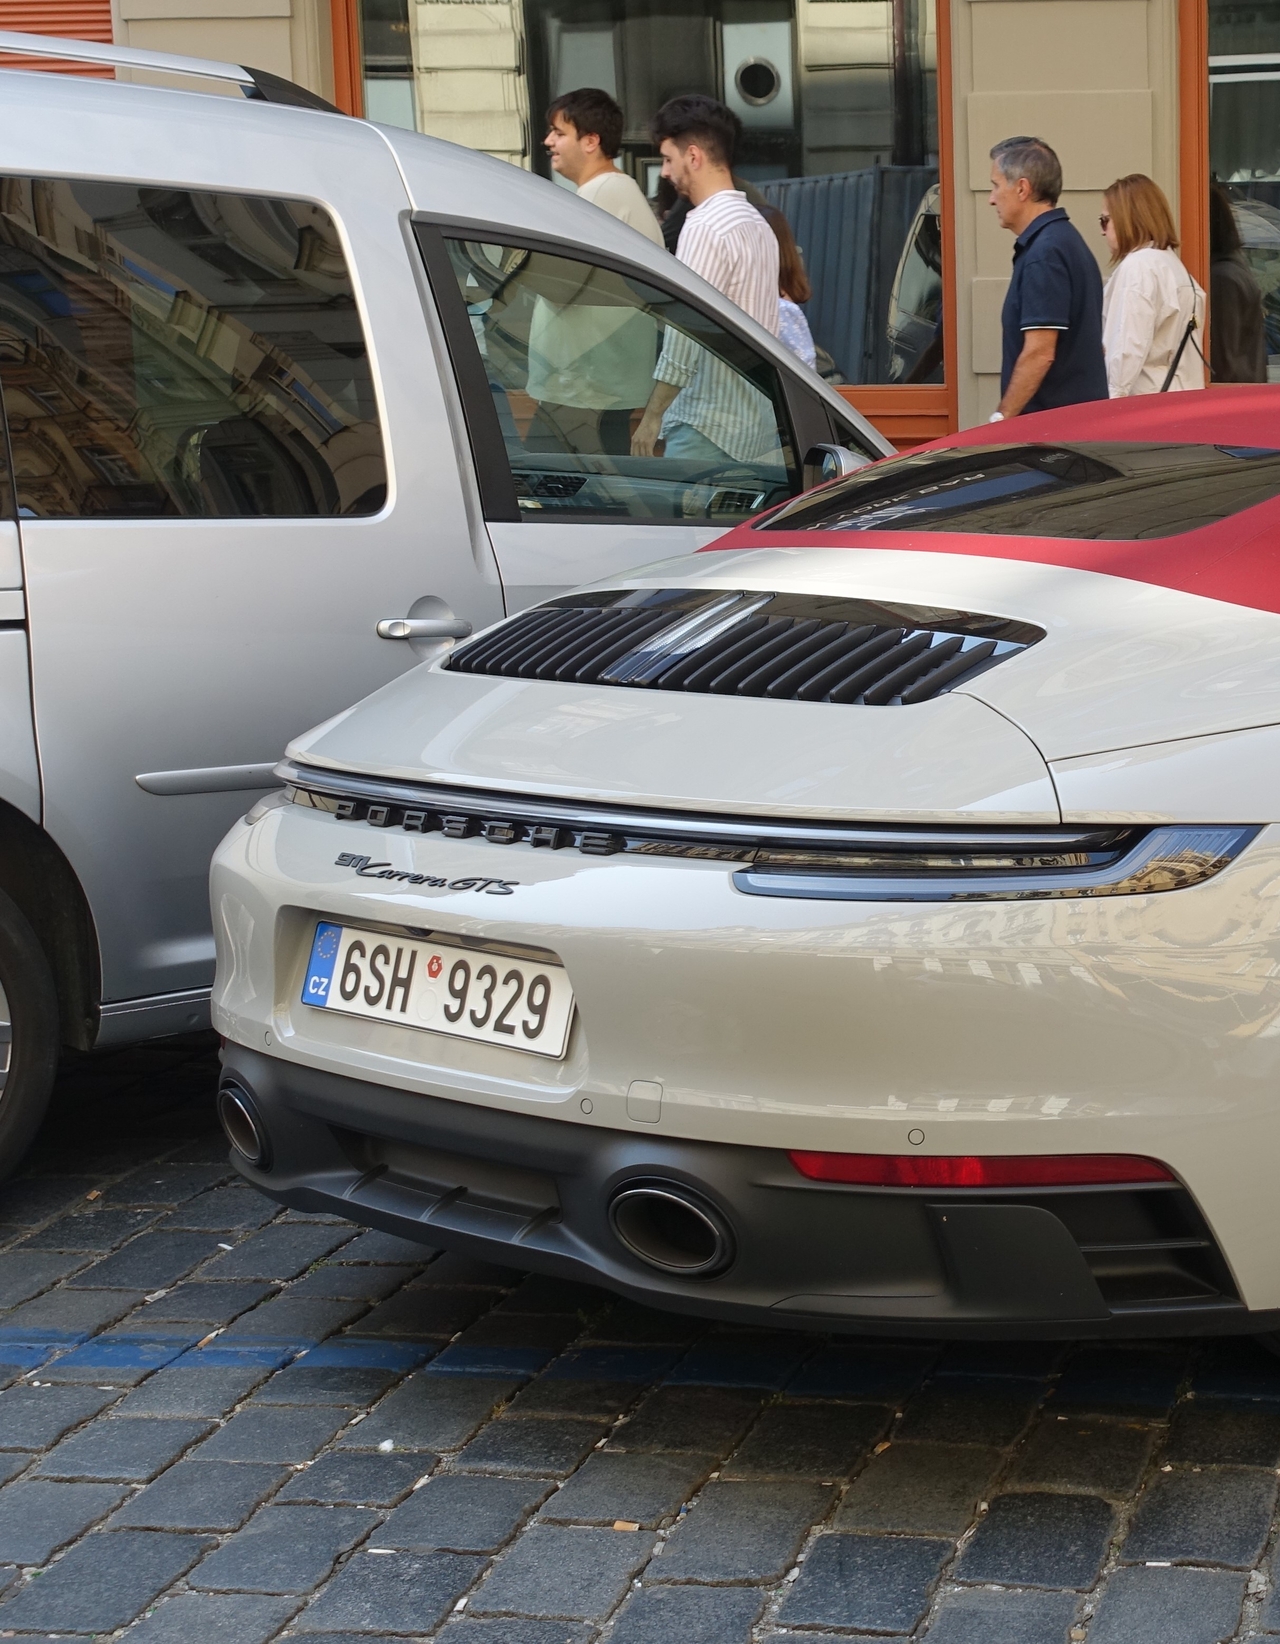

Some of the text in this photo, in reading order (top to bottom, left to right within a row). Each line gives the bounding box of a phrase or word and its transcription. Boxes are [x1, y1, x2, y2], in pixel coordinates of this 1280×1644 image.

[334, 801, 628, 856] PORSCHE
[356, 862, 447, 888] Carrera
[448, 878, 520, 895] GTS
[309, 975, 329, 996] CZ
[340, 940, 550, 1039] 6SH 9329
